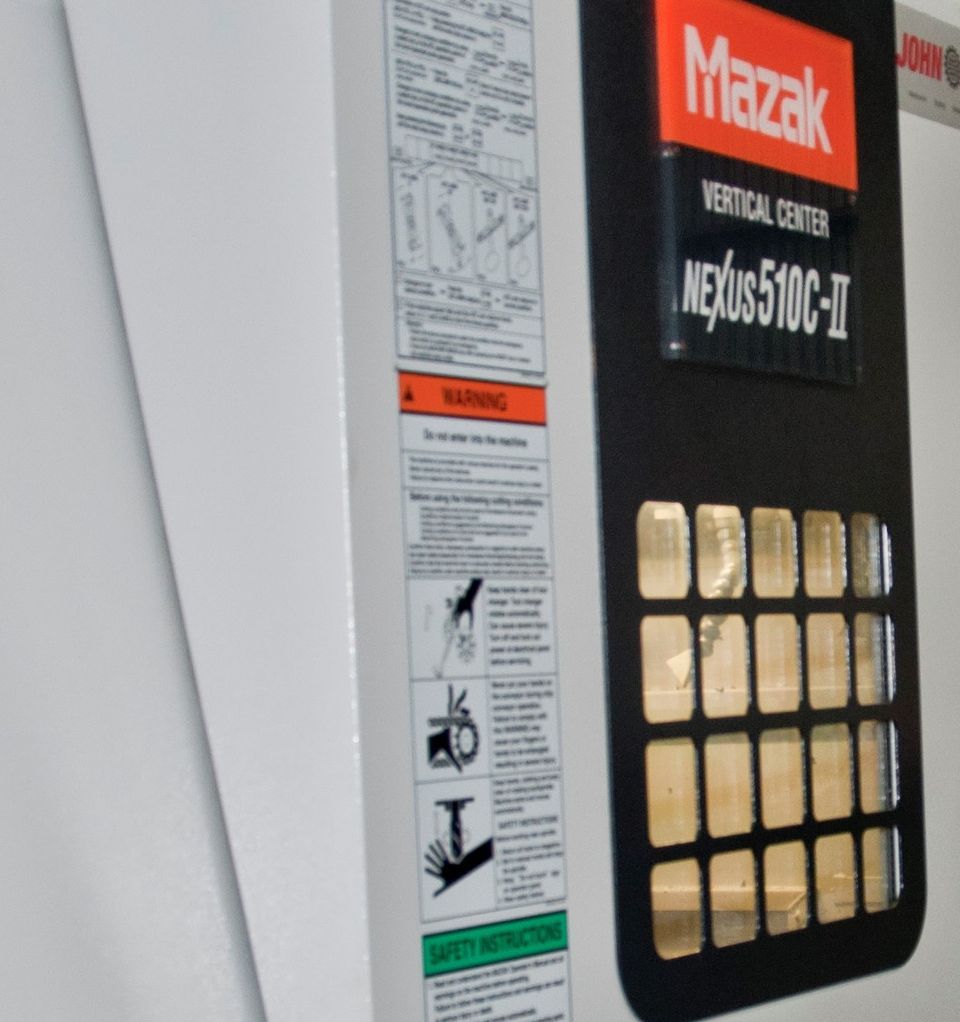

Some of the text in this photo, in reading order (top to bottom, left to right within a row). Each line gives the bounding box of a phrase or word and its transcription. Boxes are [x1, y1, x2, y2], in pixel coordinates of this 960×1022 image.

[894, 31, 944, 82] JOHN
[683, 23, 833, 155] Mazak
[701, 177, 830, 240] VERTICAL CENTER
[442, 386, 508, 412] WARNING
[428, 920, 562, 966] SAFETY INSTRUCTIONS
